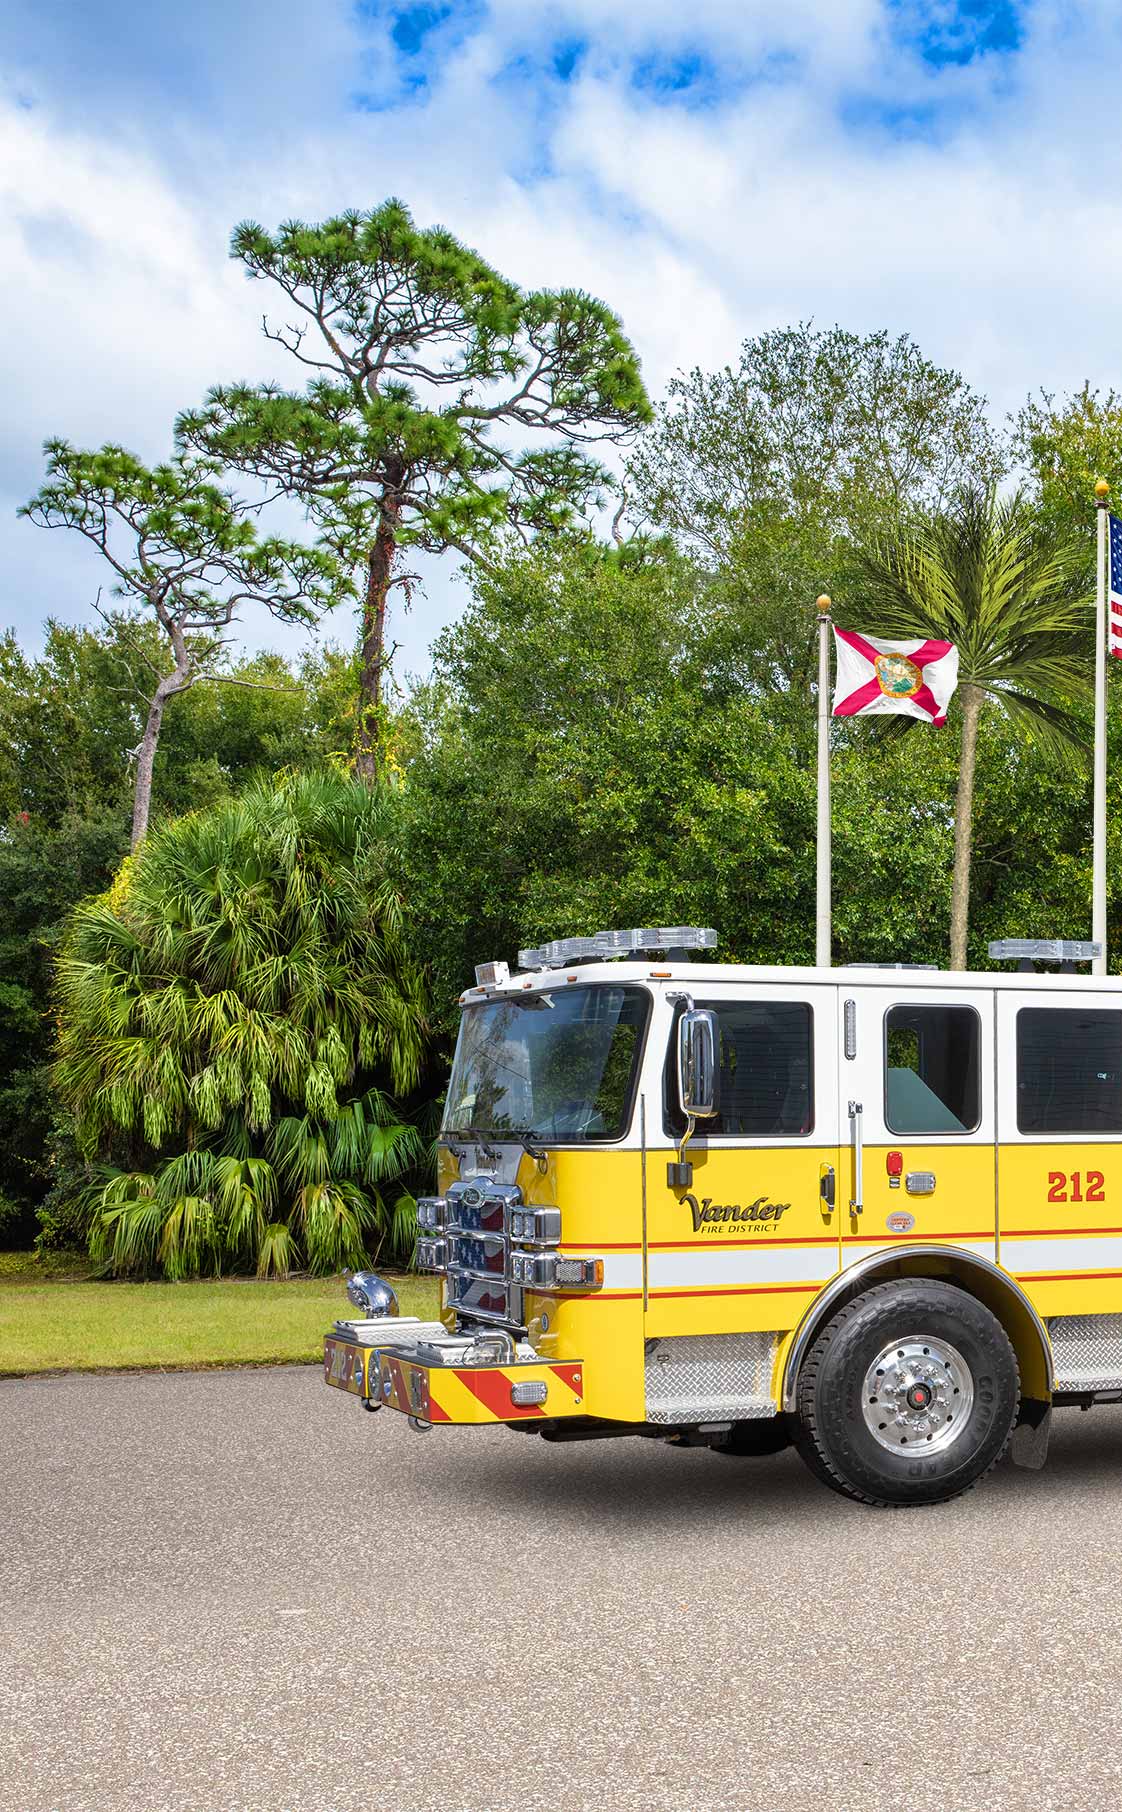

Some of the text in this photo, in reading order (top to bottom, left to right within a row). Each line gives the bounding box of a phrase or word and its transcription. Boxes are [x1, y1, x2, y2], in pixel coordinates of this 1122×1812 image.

[1048, 1171, 1105, 1202] 212
[679, 1193, 791, 1232] Vander
[701, 1224, 780, 1234] FIRE DISTRICT
